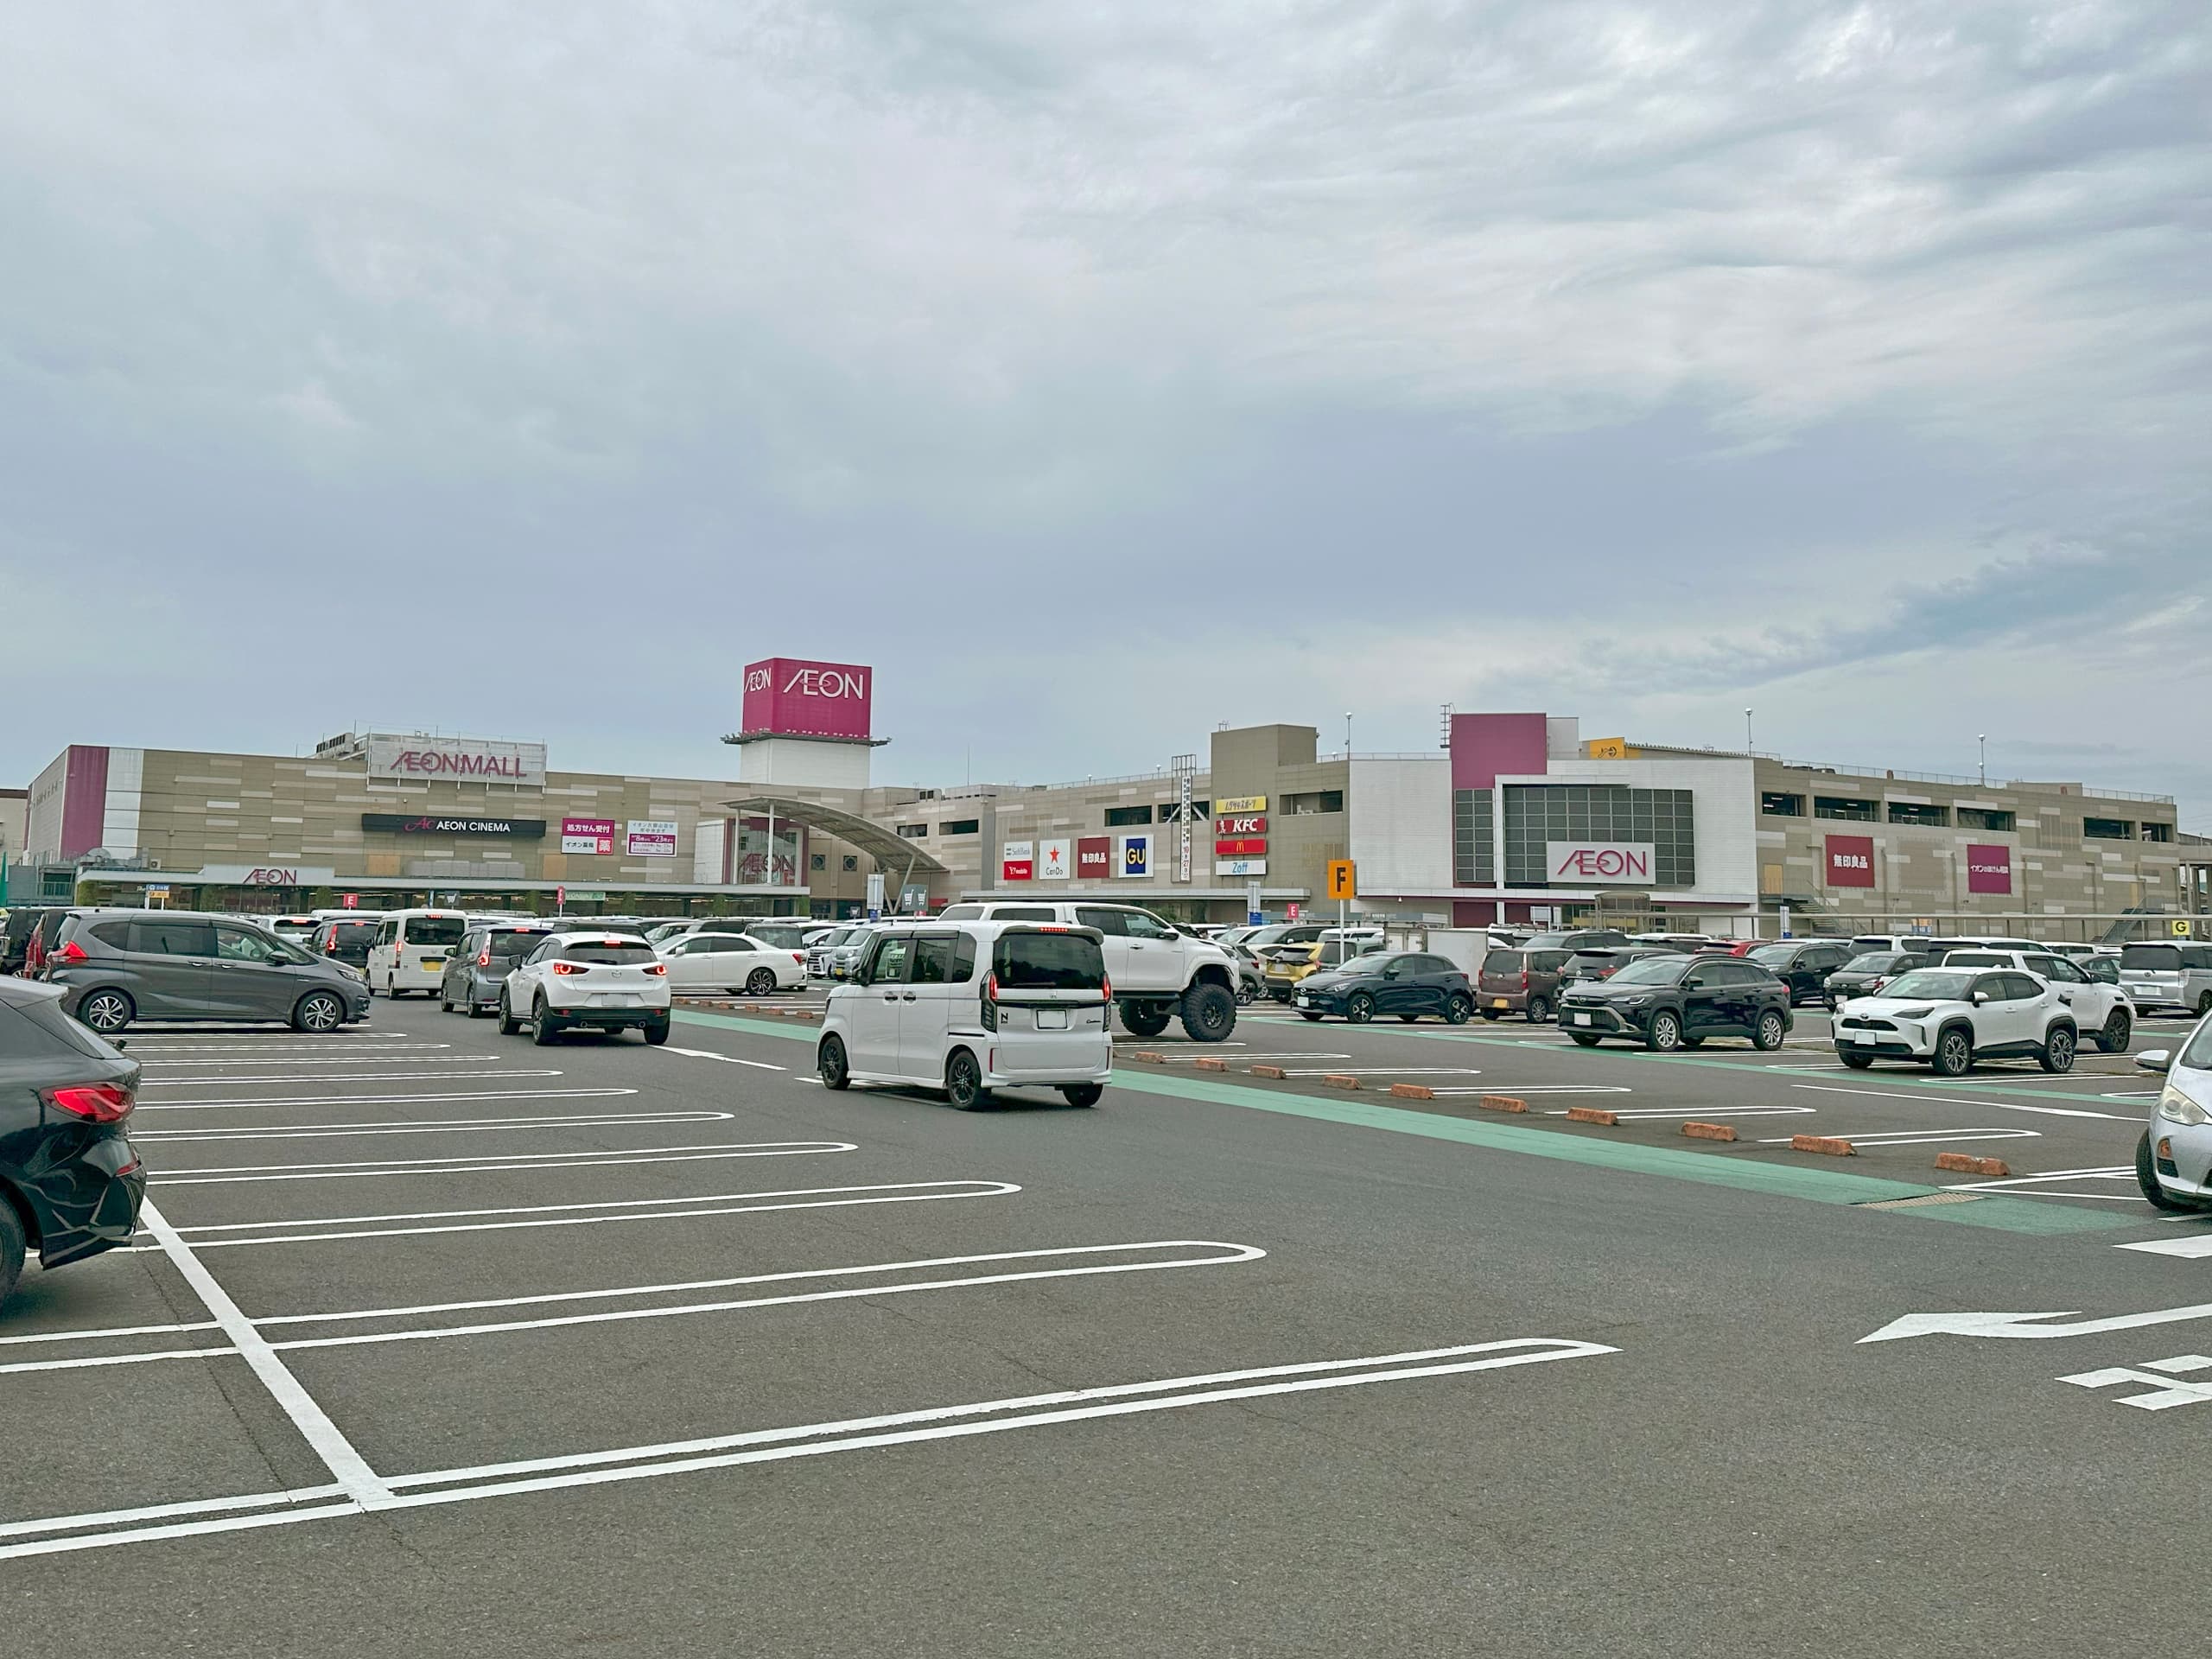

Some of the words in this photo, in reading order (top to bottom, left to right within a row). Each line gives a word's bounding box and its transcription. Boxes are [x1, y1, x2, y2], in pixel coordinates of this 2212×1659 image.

[436, 821, 467, 831] AEON
[468, 822, 511, 832] CINEMA
[567, 823, 610, 834] 処方せん受付
[1233, 819, 1258, 831] KFC
[1082, 851, 1107, 864] 無印良品
[1127, 848, 1146, 865] GU
[1834, 854, 1868, 869] 無印良品
[1046, 867, 1064, 876] CanDo
[1232, 862, 1248, 874] Zoff
[1337, 868, 1345, 892] F
[348, 895, 354, 905] E
[1291, 906, 1296, 915] E
[2175, 921, 2187, 933] G
